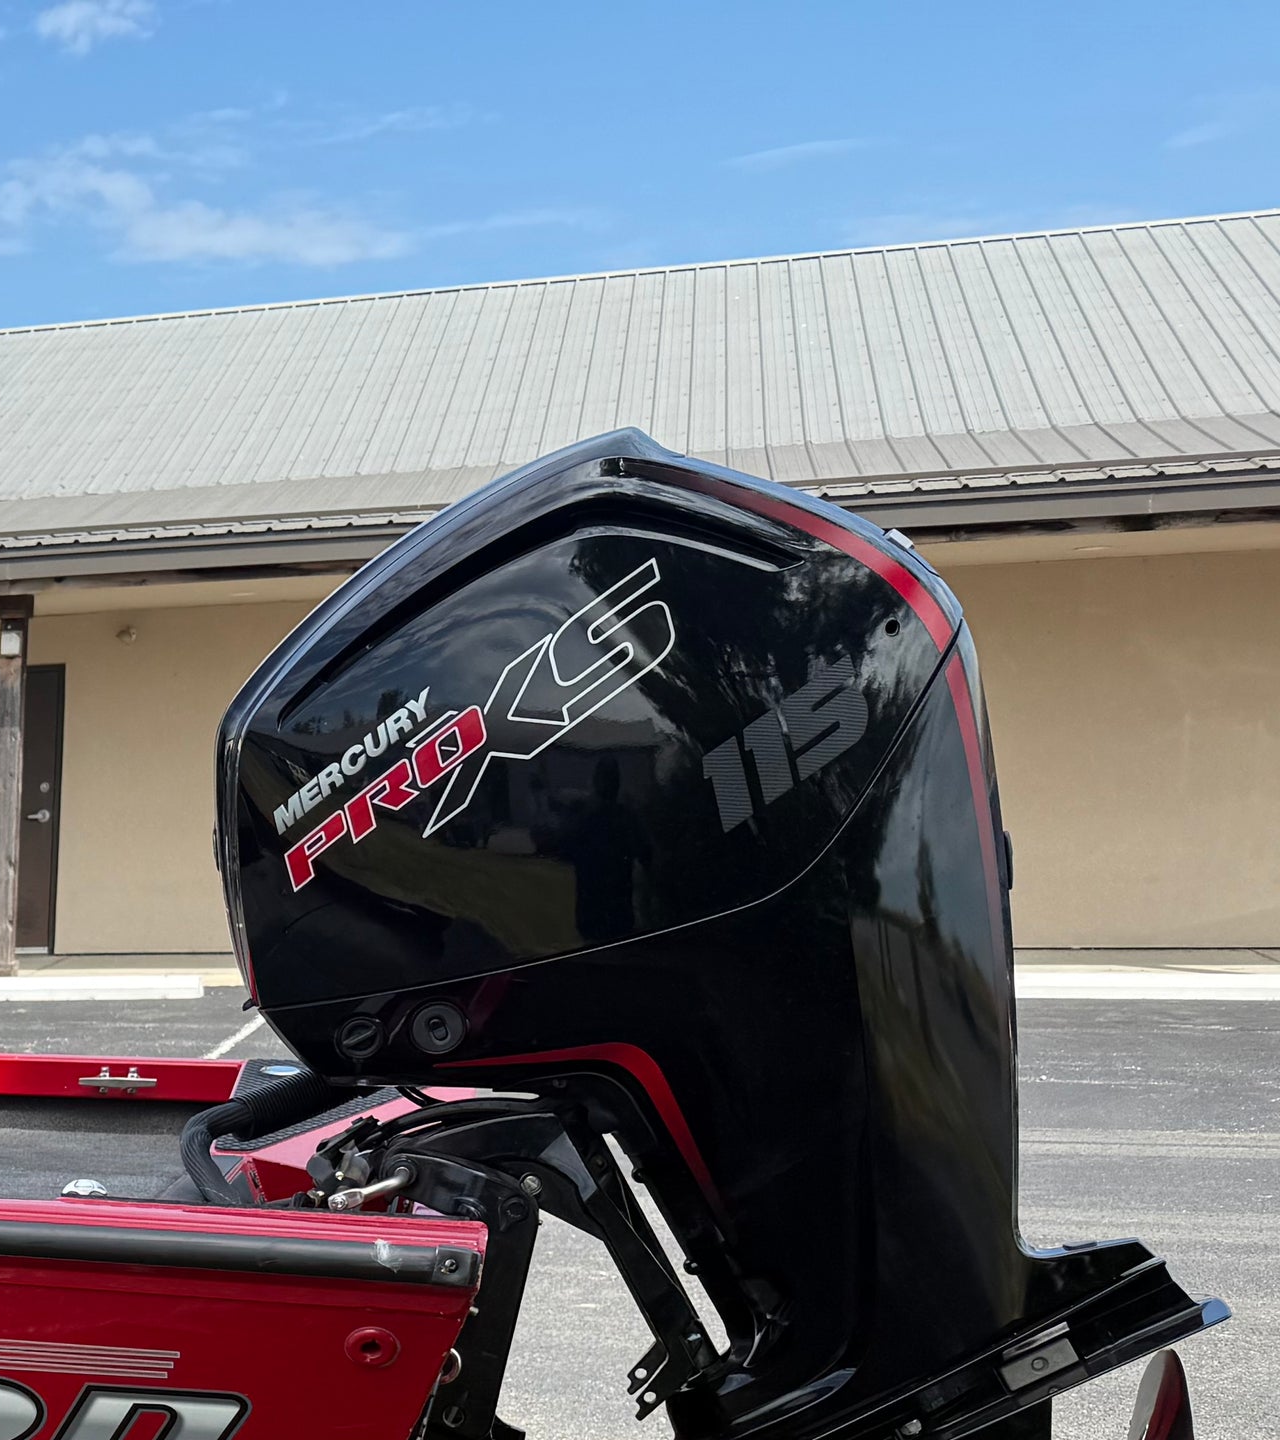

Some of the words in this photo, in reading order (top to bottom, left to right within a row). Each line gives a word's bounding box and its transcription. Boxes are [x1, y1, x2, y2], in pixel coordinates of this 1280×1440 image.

[273, 686, 430, 836] MERCURY
[283, 704, 488, 893] PRO
[406, 558, 676, 839] XS
[702, 653, 869, 834] 115
